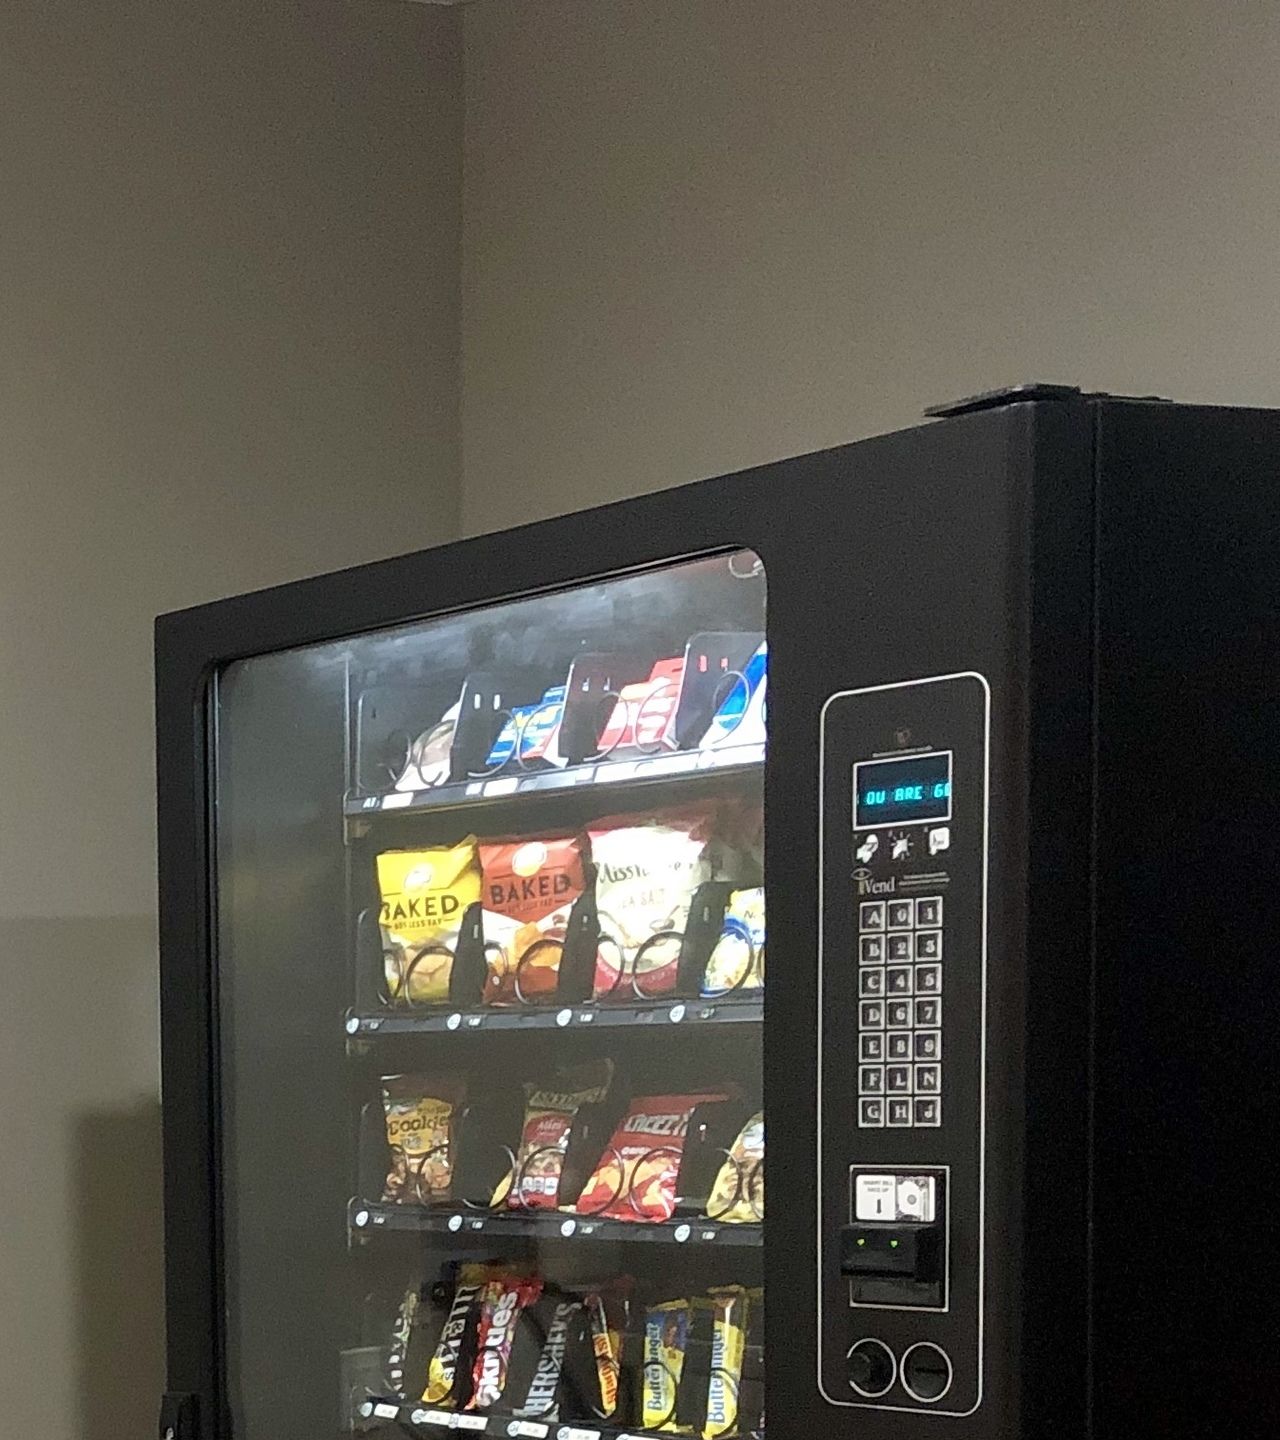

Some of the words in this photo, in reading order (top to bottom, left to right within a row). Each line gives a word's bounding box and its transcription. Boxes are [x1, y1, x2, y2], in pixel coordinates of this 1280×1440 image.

[856, 791, 886, 805] OU
[894, 785, 923, 801] ARE
[491, 873, 572, 905] BAKED
[381, 895, 460, 921] BAKED
[868, 910, 880, 924] A
[927, 907, 934, 920] 1
[869, 943, 880, 957] B
[897, 941, 906, 955] 2
[867, 974, 879, 989] C
[896, 974, 905, 988] 4
[868, 1008, 880, 1022] D
[896, 1007, 906, 1020] 6
[924, 1006, 934, 1020] 7
[868, 1040, 880, 1054] E
[896, 1040, 905, 1053] 8
[869, 1072, 880, 1086] F
[896, 1073, 906, 1086] L
[923, 1072, 935, 1086] N
[867, 1105, 879, 1118] G
[895, 1105, 907, 1118] H
[522, 1302, 583, 1417] HERSHEY'S
[646, 1323, 663, 1411] Butteringer
[707, 1328, 726, 1424] Butteringer
